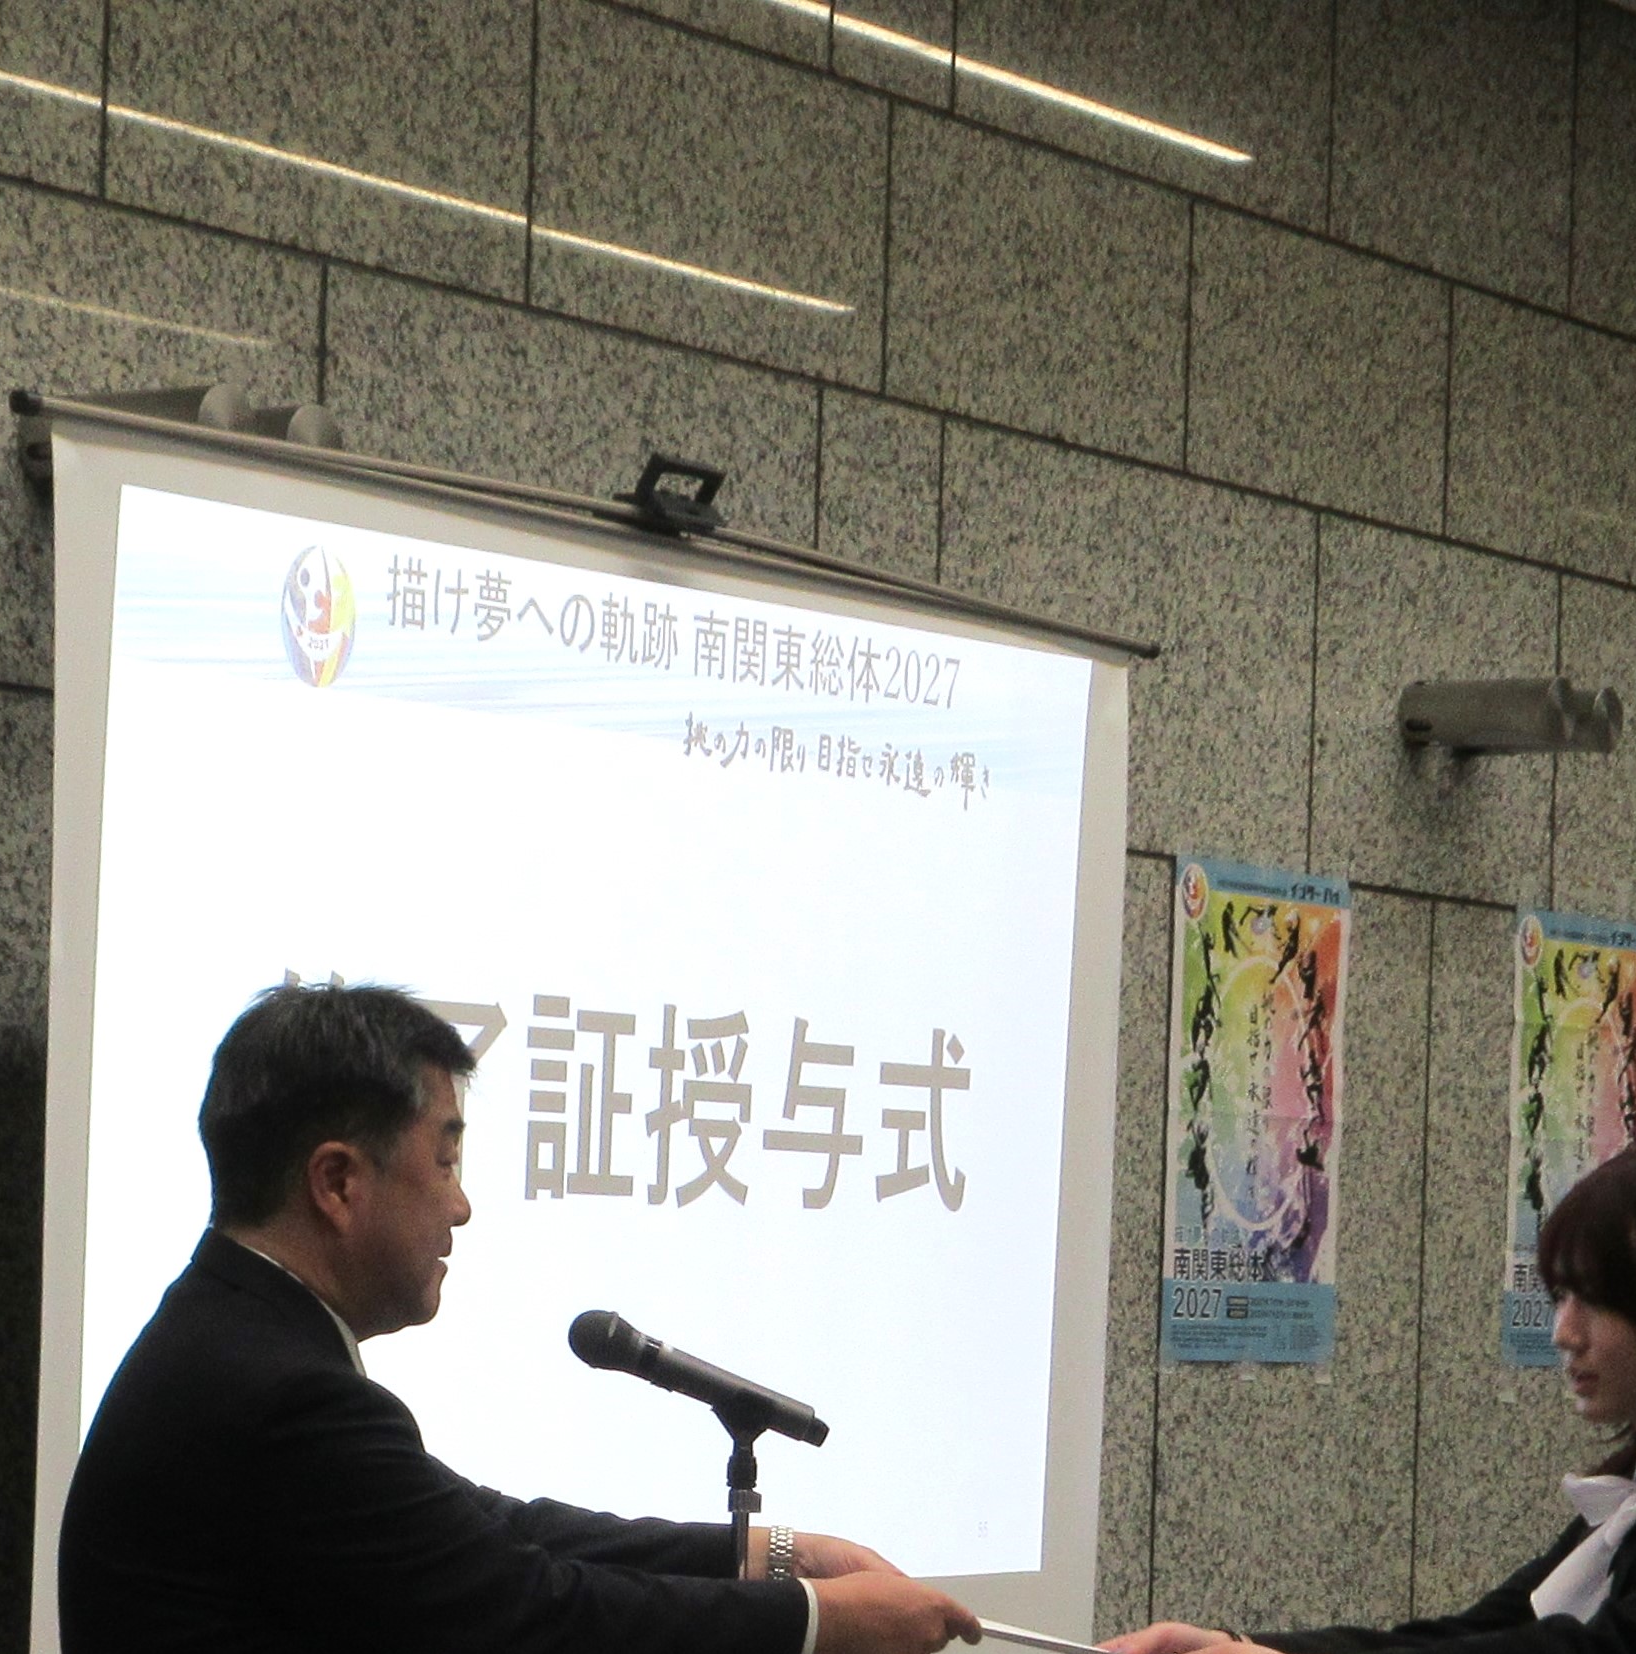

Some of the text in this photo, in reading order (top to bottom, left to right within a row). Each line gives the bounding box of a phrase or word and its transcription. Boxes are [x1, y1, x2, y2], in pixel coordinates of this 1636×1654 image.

[385, 553, 962, 710] 描け夢への軌跡 南関東総体2027
[283, 966, 971, 1213] 証授与式
[1171, 1286, 1222, 1319] 2027
